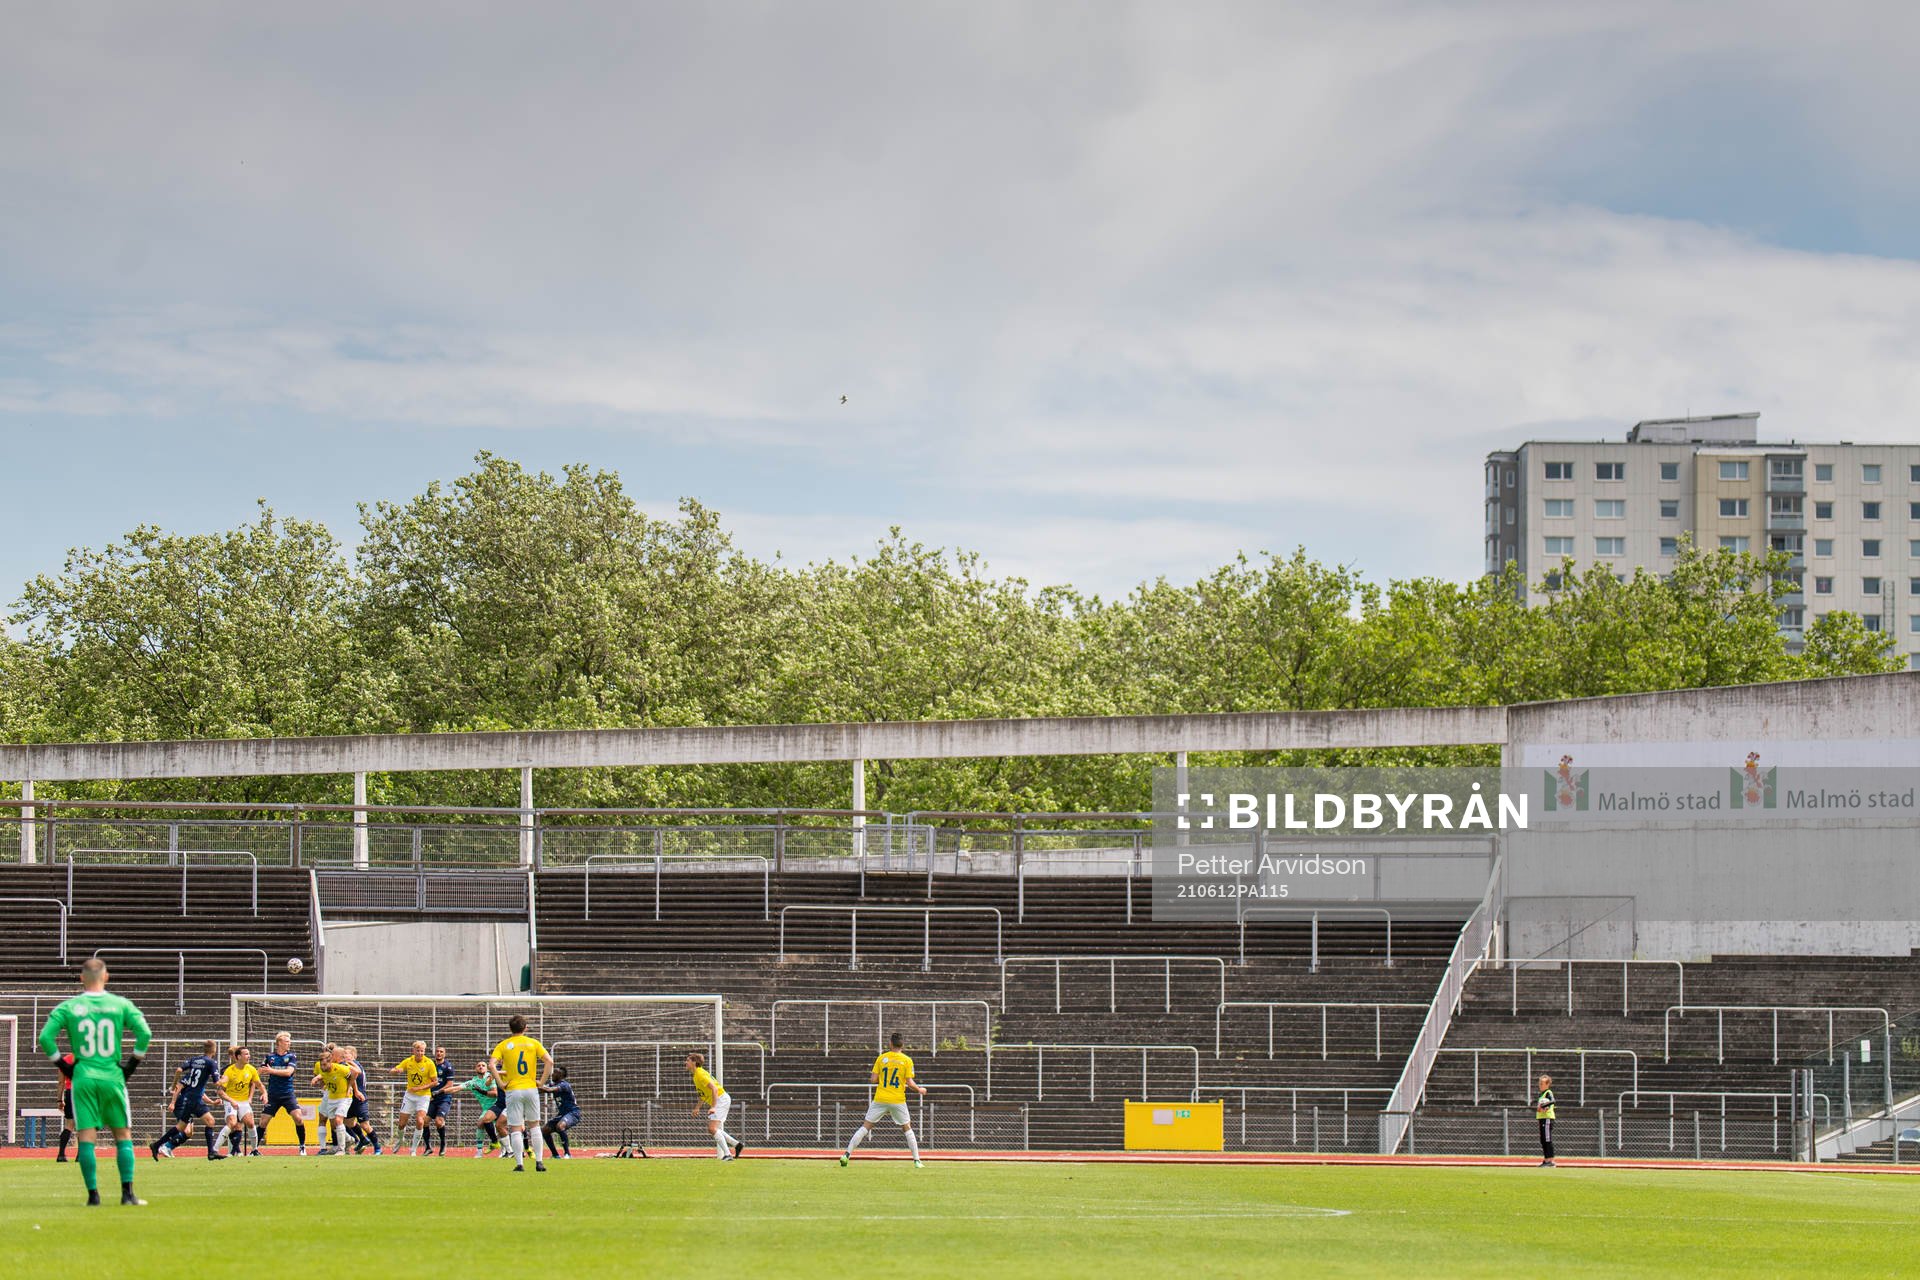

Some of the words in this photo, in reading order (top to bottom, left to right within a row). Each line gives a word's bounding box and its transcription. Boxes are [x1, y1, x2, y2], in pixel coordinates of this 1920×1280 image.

[1598, 792, 1670, 811] Malmö
[1676, 791, 1721, 810] stad
[1785, 789, 1861, 809] Malmö
[1867, 787, 1914, 808] stad
[78, 1018, 115, 1058] 30
[517, 1051, 528, 1075] 6
[882, 1067, 900, 1089] 14
